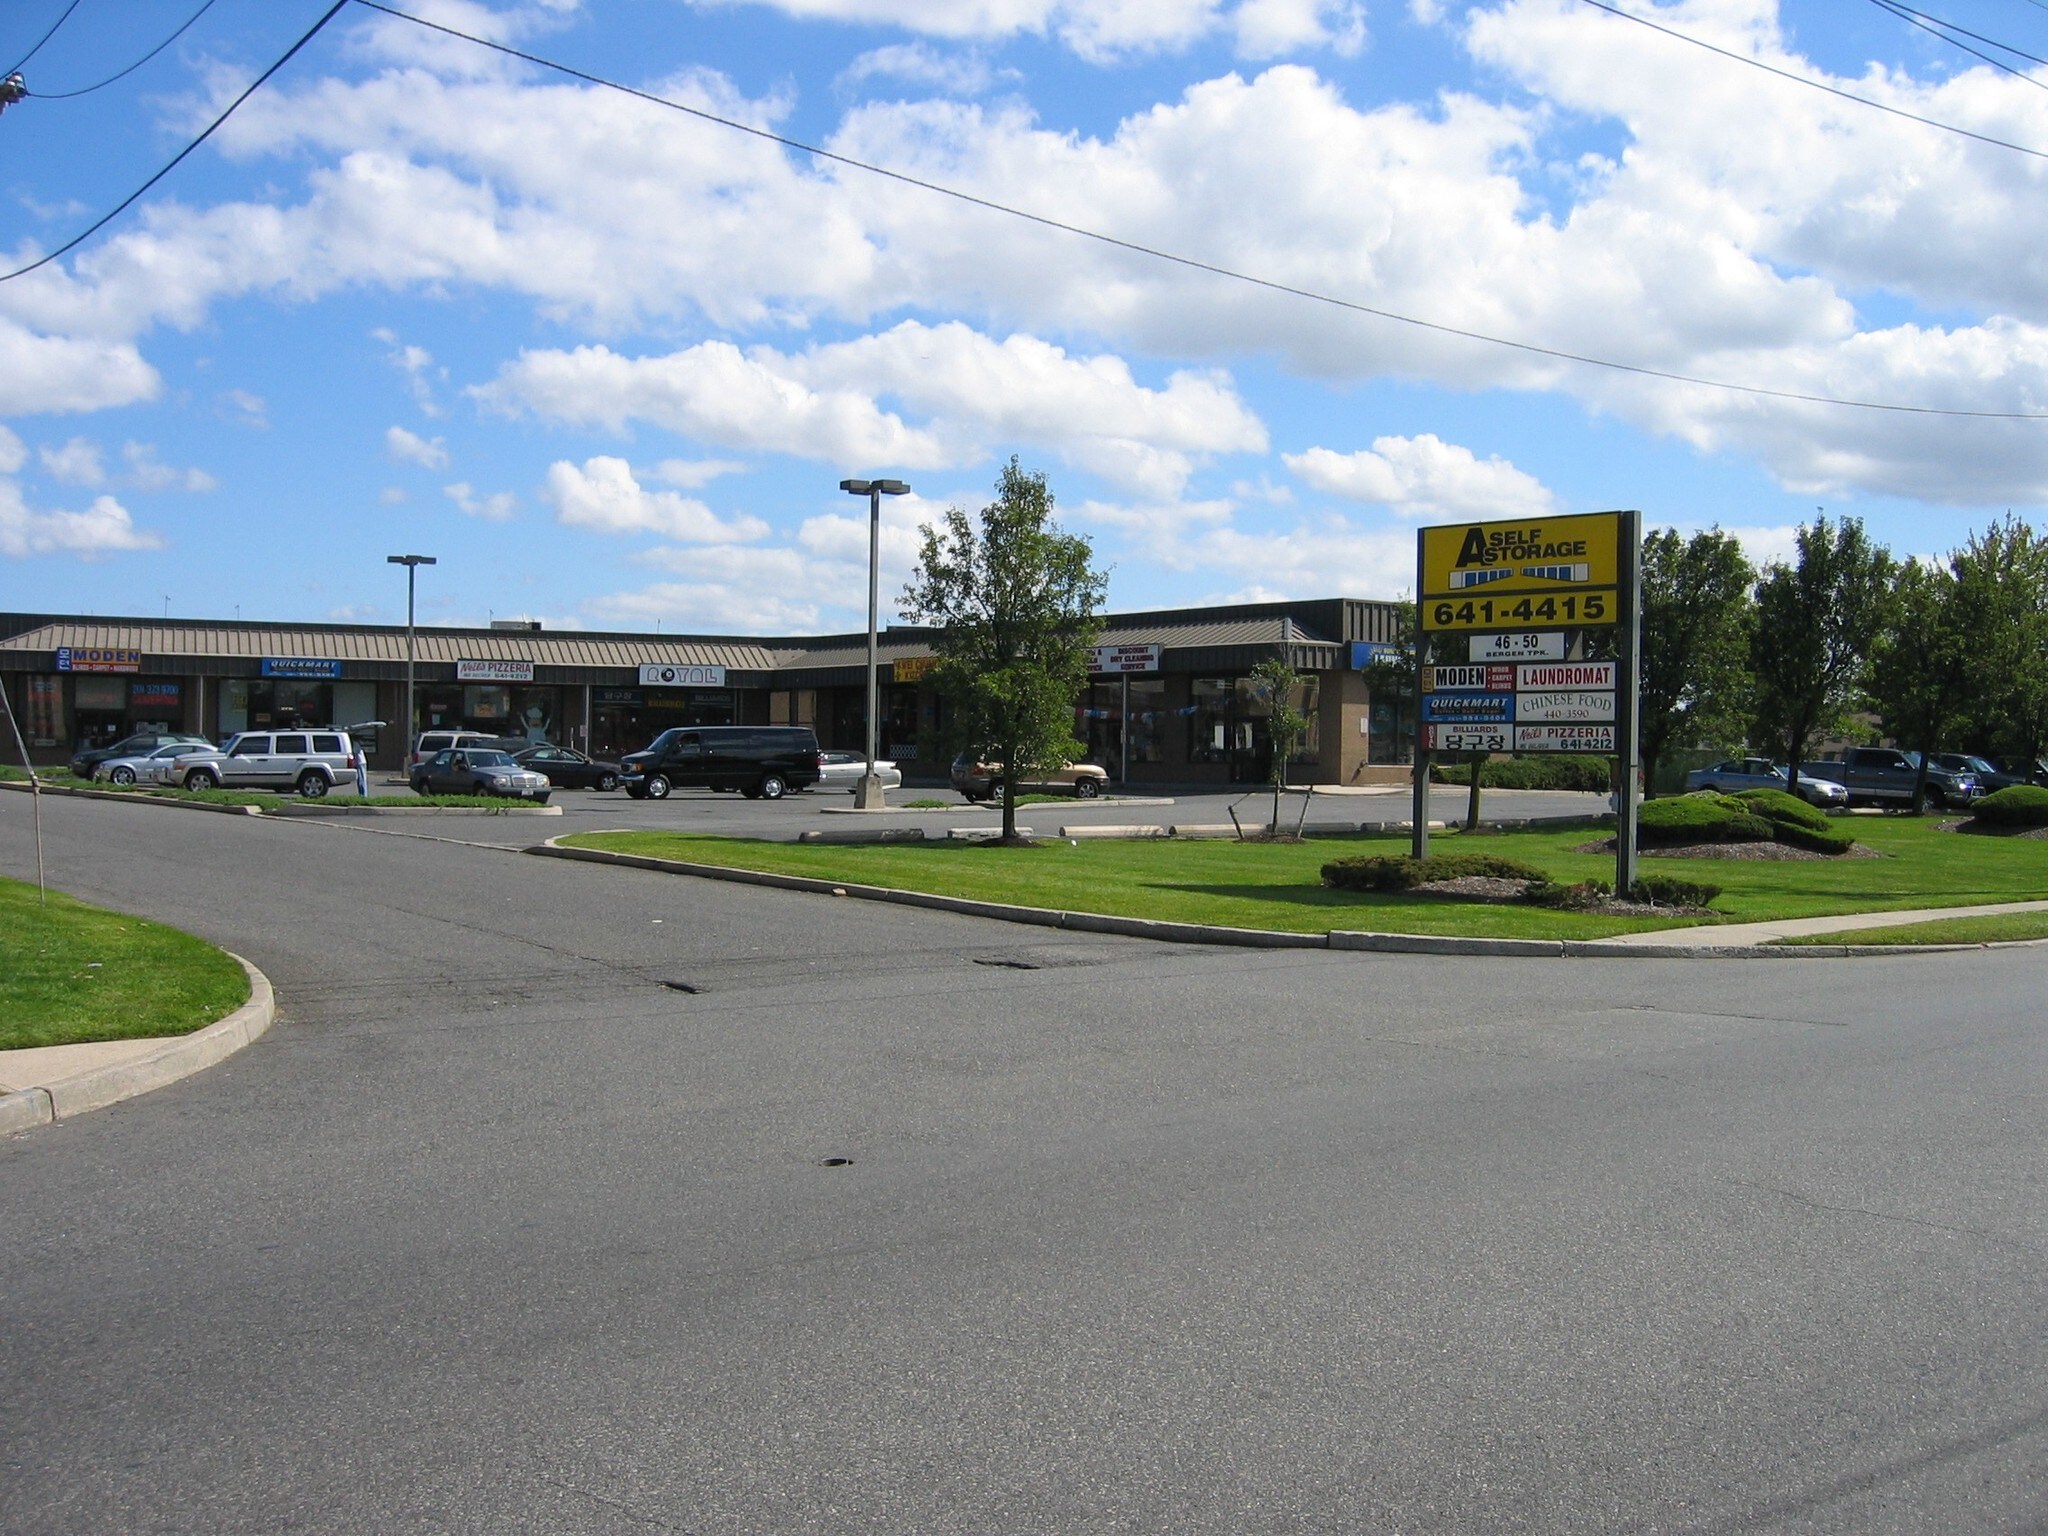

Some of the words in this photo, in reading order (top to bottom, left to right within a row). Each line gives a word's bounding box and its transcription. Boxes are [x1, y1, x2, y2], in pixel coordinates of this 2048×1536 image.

[1489, 529, 1542, 547] SELF
[1455, 527, 1493, 568] A
[1482, 541, 1587, 562] STORAGE
[1434, 595, 1605, 625] 641-4415
[1495, 636, 1511, 649] 46
[1523, 635, 1539, 649] 50
[73, 650, 140, 662] MODEN
[488, 663, 531, 673] PIZZERIA
[647, 667, 718, 683] ROYAL
[1435, 667, 1485, 686] MODEN
[1523, 667, 1610, 685] LAUNDROMAT
[1431, 698, 1509, 708] QUICKMART
[1523, 693, 1573, 712] CHINESE
[1579, 694, 1612, 710] FOOD
[1544, 710, 1561, 718] 440
[1567, 710, 1589, 718] 3590
[1547, 728, 1611, 738] PIZZERIA
[1445, 735, 1506, 750] 당구장
[1561, 739, 1612, 749] 641-4212
